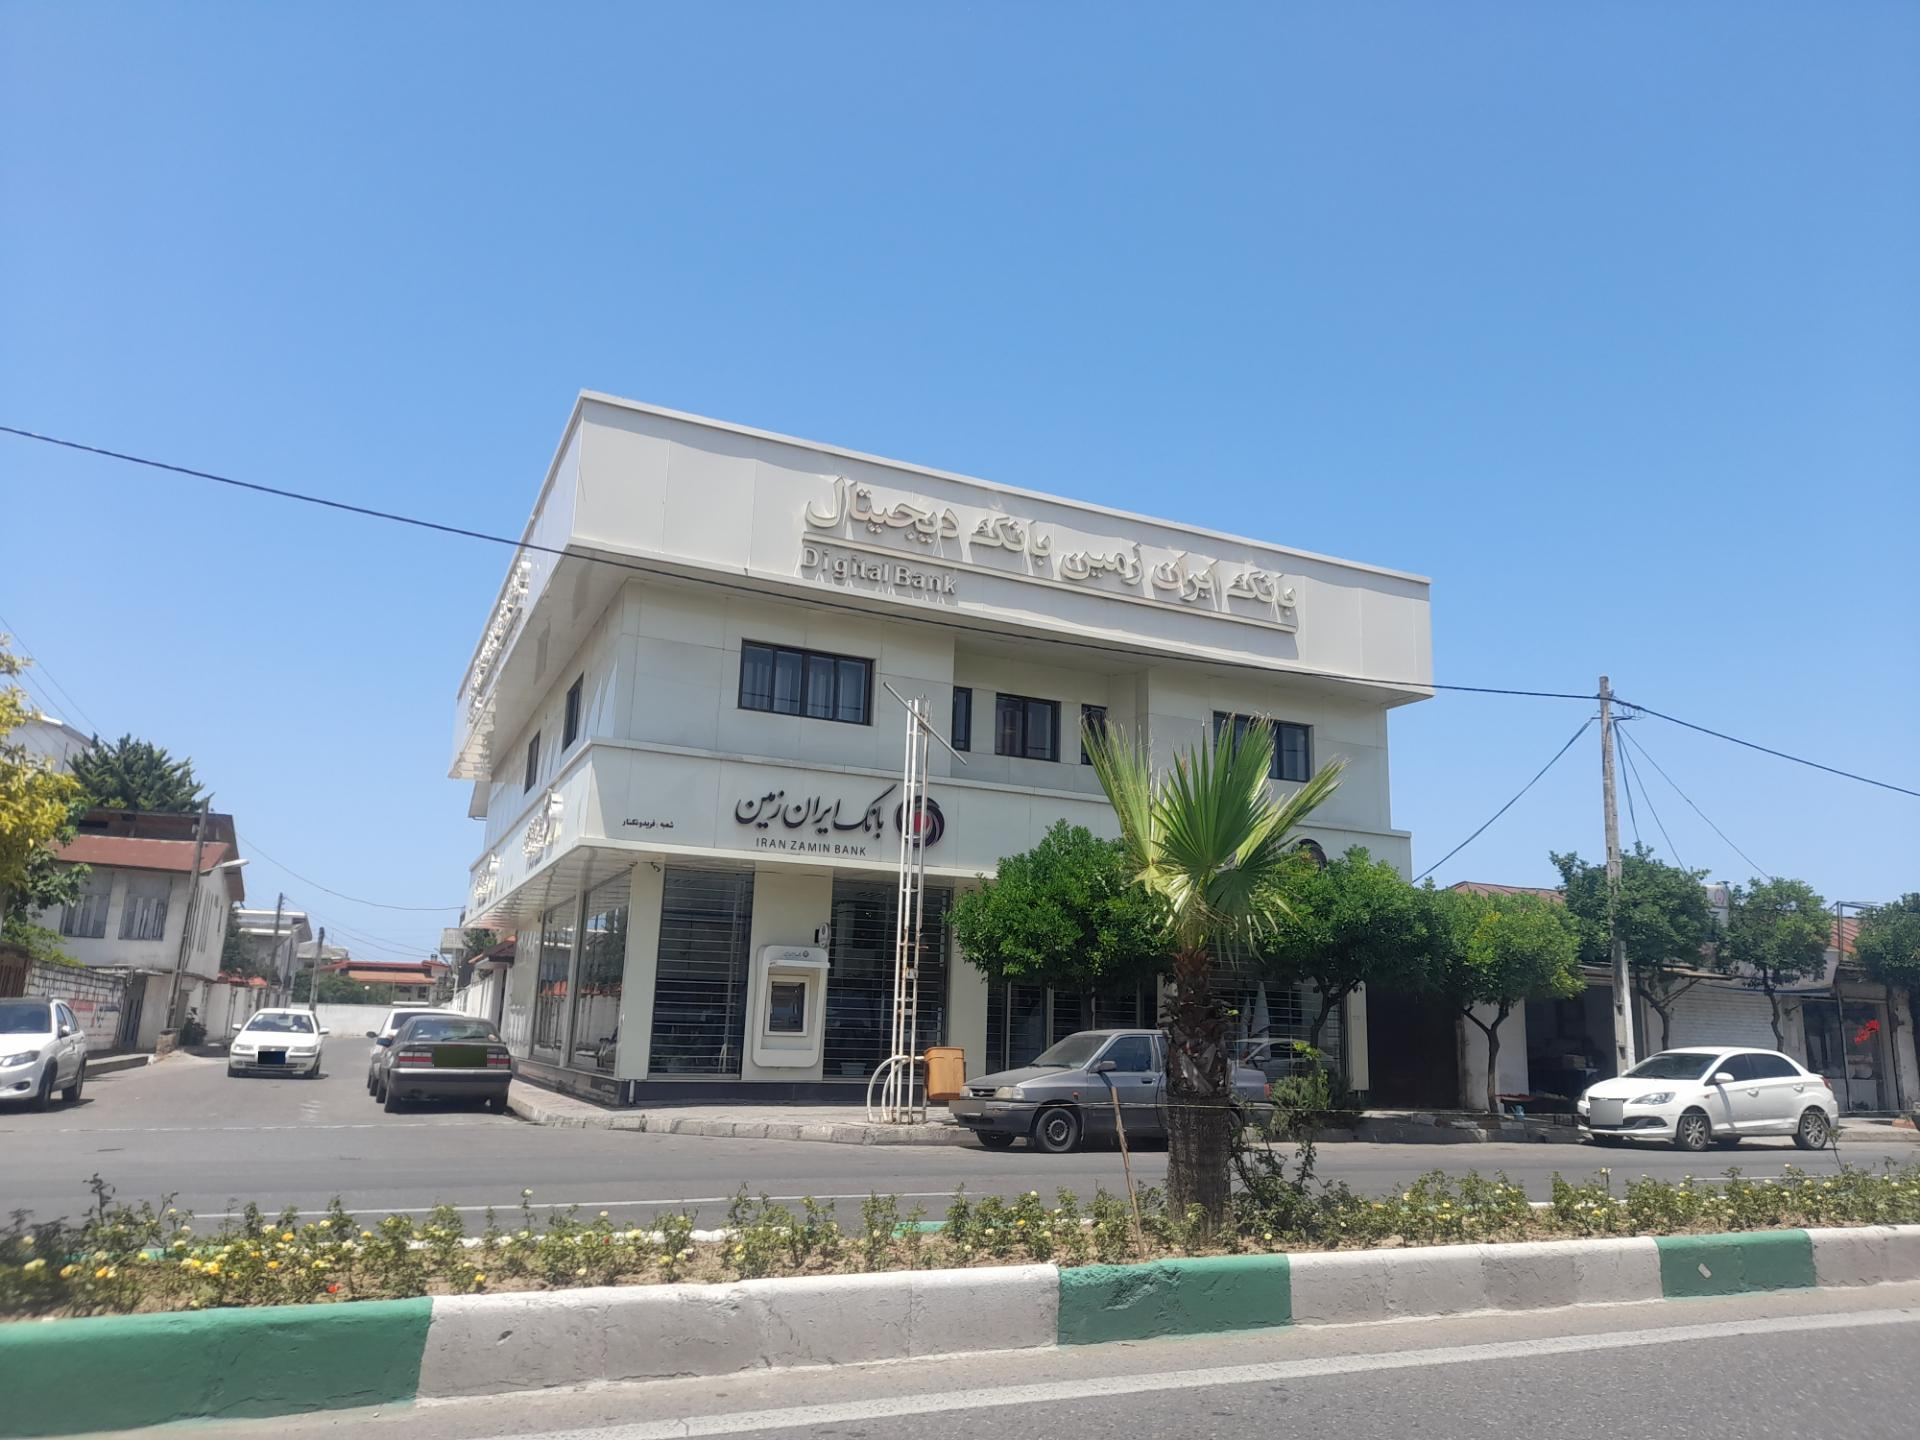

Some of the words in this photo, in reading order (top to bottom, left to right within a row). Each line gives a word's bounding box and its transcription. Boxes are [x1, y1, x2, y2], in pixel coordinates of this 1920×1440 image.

[804, 475, 960, 545] دیجیتال
[800, 546, 890, 582] Digital
[893, 564, 959, 596] Bank
[1060, 541, 1145, 586] زمین
[1152, 551, 1220, 602] ایران
[735, 789, 785, 829] زمین
[782, 795, 841, 834] ایران
[833, 783, 898, 840] بانک
[755, 837, 787, 850] IRAN
[790, 840, 831, 854] ZAMIN
[834, 844, 867, 857] BANK
